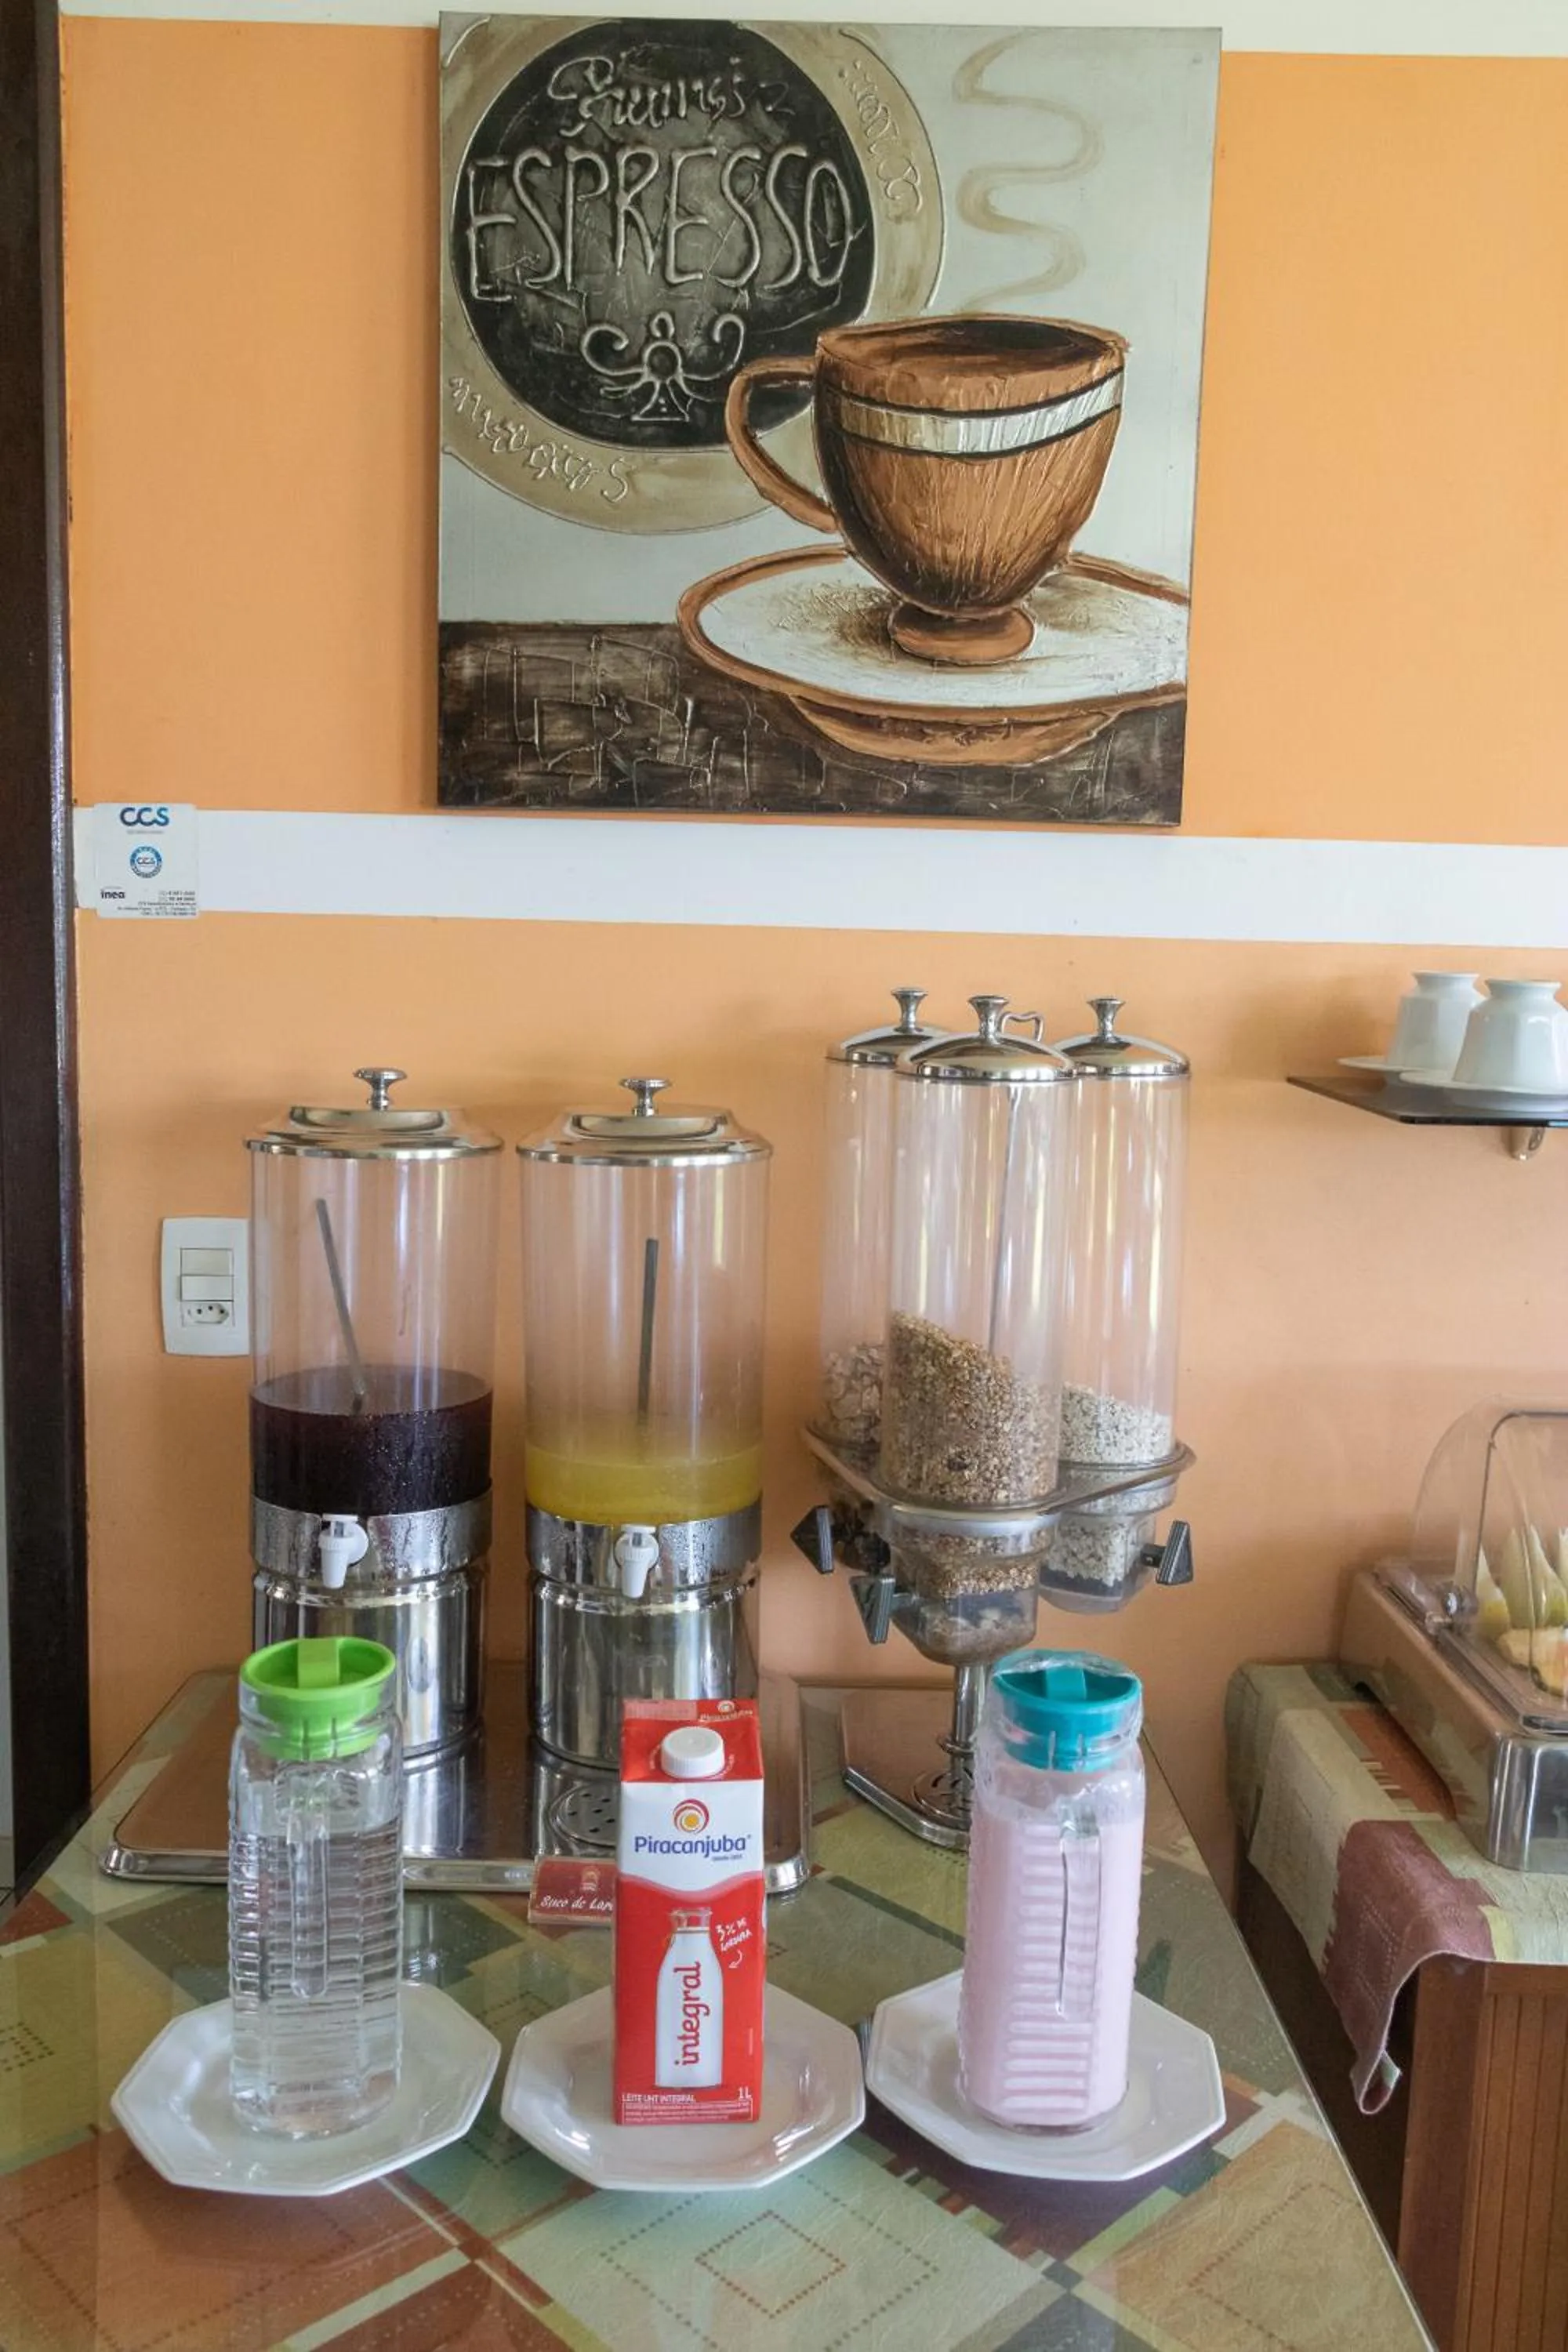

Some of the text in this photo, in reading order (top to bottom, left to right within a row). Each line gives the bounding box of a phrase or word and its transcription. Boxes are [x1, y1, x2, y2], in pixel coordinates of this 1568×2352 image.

[467, 147, 850, 301] ESPRESSO
[120, 807, 170, 826] CCS
[100, 889, 125, 899] inea
[634, 1834, 746, 1859] Piracanjuba
[571, 1896, 586, 1908] de
[674, 1961, 710, 2066] integral
[738, 2086, 752, 2099] 1L
